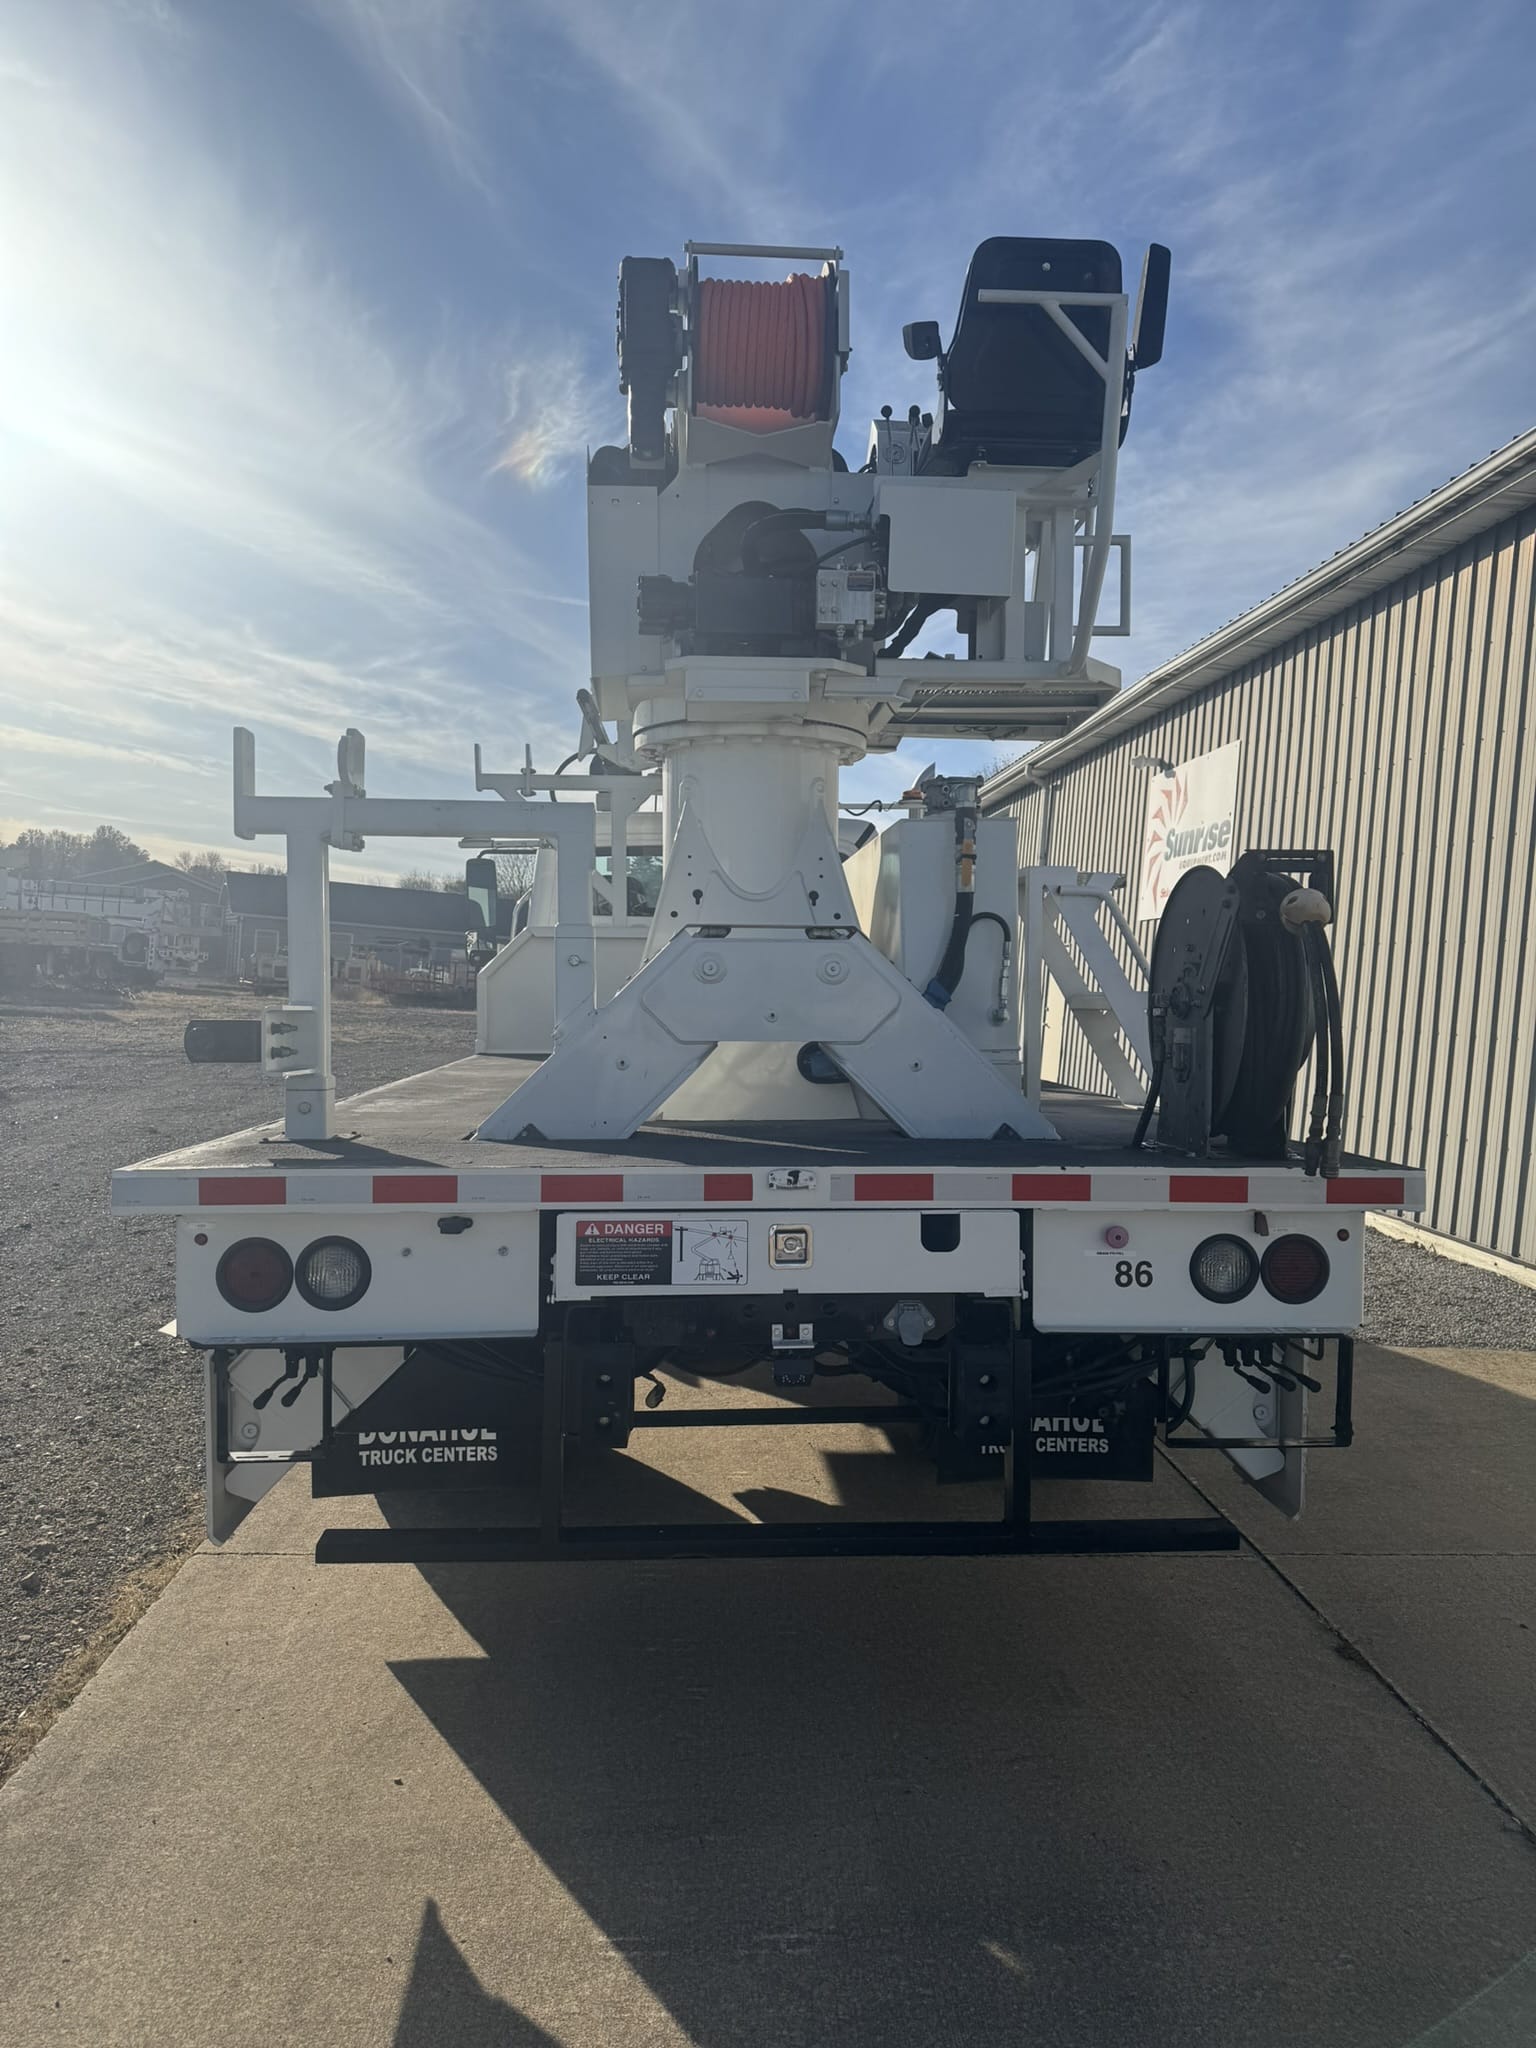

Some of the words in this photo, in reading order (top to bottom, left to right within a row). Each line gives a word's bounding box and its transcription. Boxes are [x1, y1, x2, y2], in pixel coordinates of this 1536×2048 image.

[1164, 819, 1231, 861] Sunrise
[604, 1223, 664, 1234] DANGER
[596, 1273, 620, 1281] KEEP
[1114, 1260, 1153, 1288] 86
[1035, 1437, 1109, 1453] CENTERS
[359, 1449, 417, 1466] TRUCK
[422, 1446, 498, 1462] CENTERS
